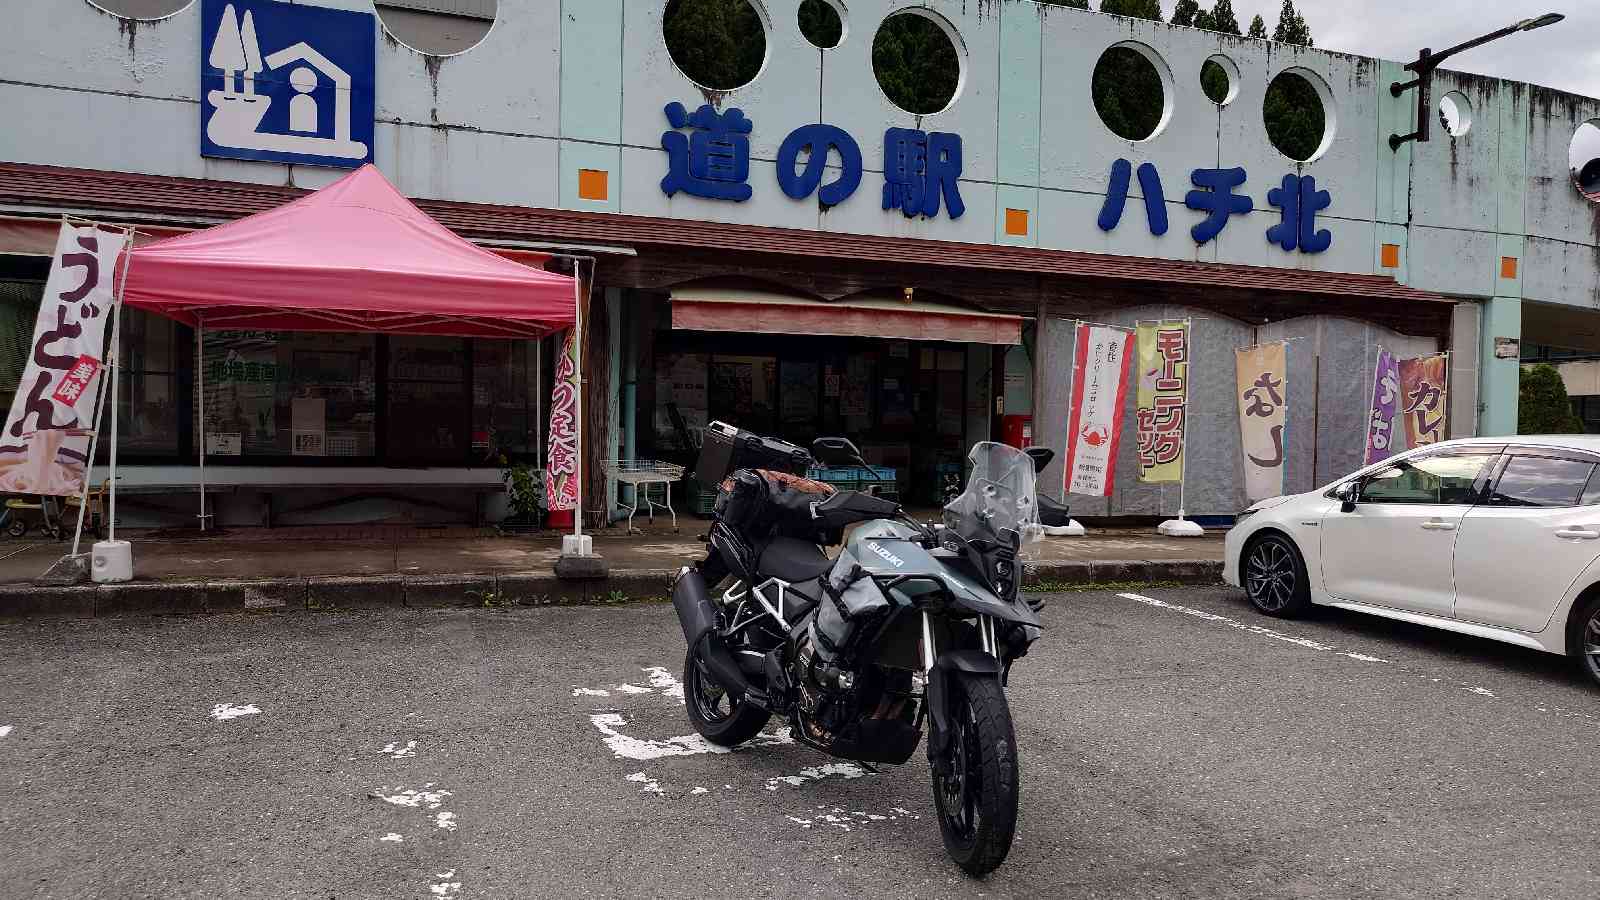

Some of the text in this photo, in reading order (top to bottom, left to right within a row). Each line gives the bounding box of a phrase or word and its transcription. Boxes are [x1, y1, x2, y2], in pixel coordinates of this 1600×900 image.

[661, 100, 1332, 254] 道の駅 ハチ北
[10, 236, 100, 438] うどん
[1154, 330, 1185, 464] モーニング
[1136, 408, 1156, 478] セット
[867, 542, 904, 568] SUZUKI
